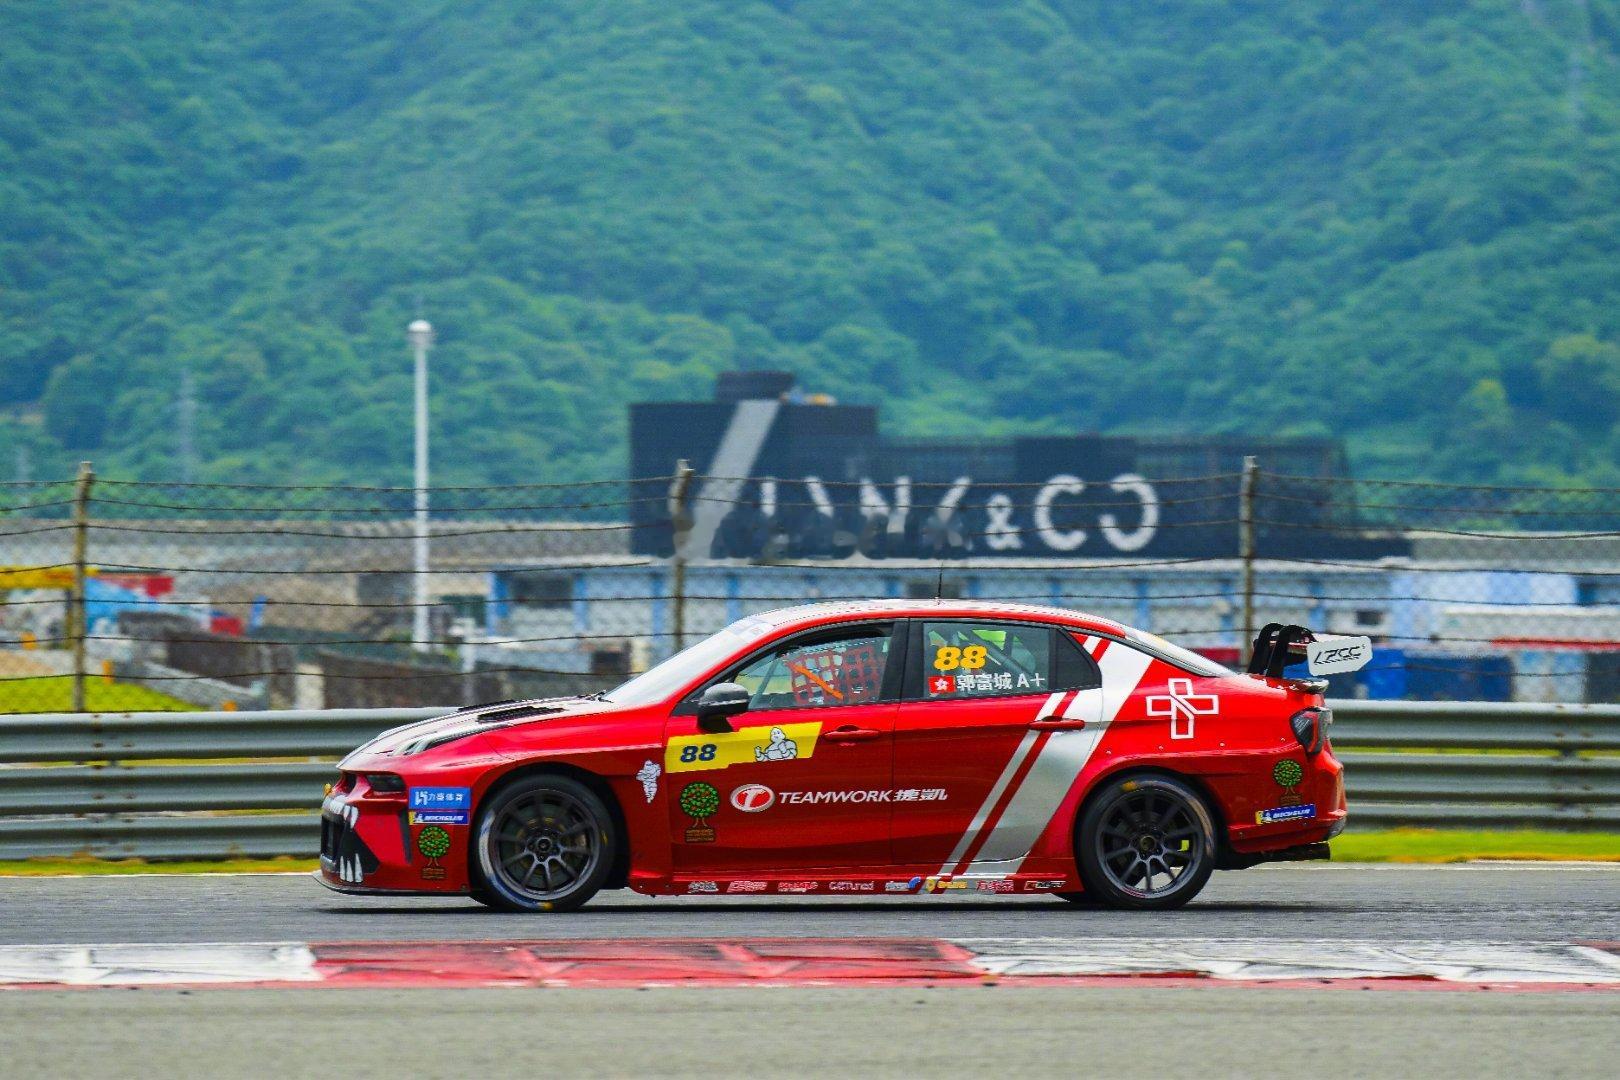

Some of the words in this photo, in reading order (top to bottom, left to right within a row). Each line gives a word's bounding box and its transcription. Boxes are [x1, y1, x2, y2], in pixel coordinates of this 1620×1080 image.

[933, 645, 988, 671] 88
[957, 672, 1012, 691] 郭富城
[1017, 672, 1046, 688] A+
[680, 743, 717, 763] 88
[779, 789, 893, 804] TEAMWORK
